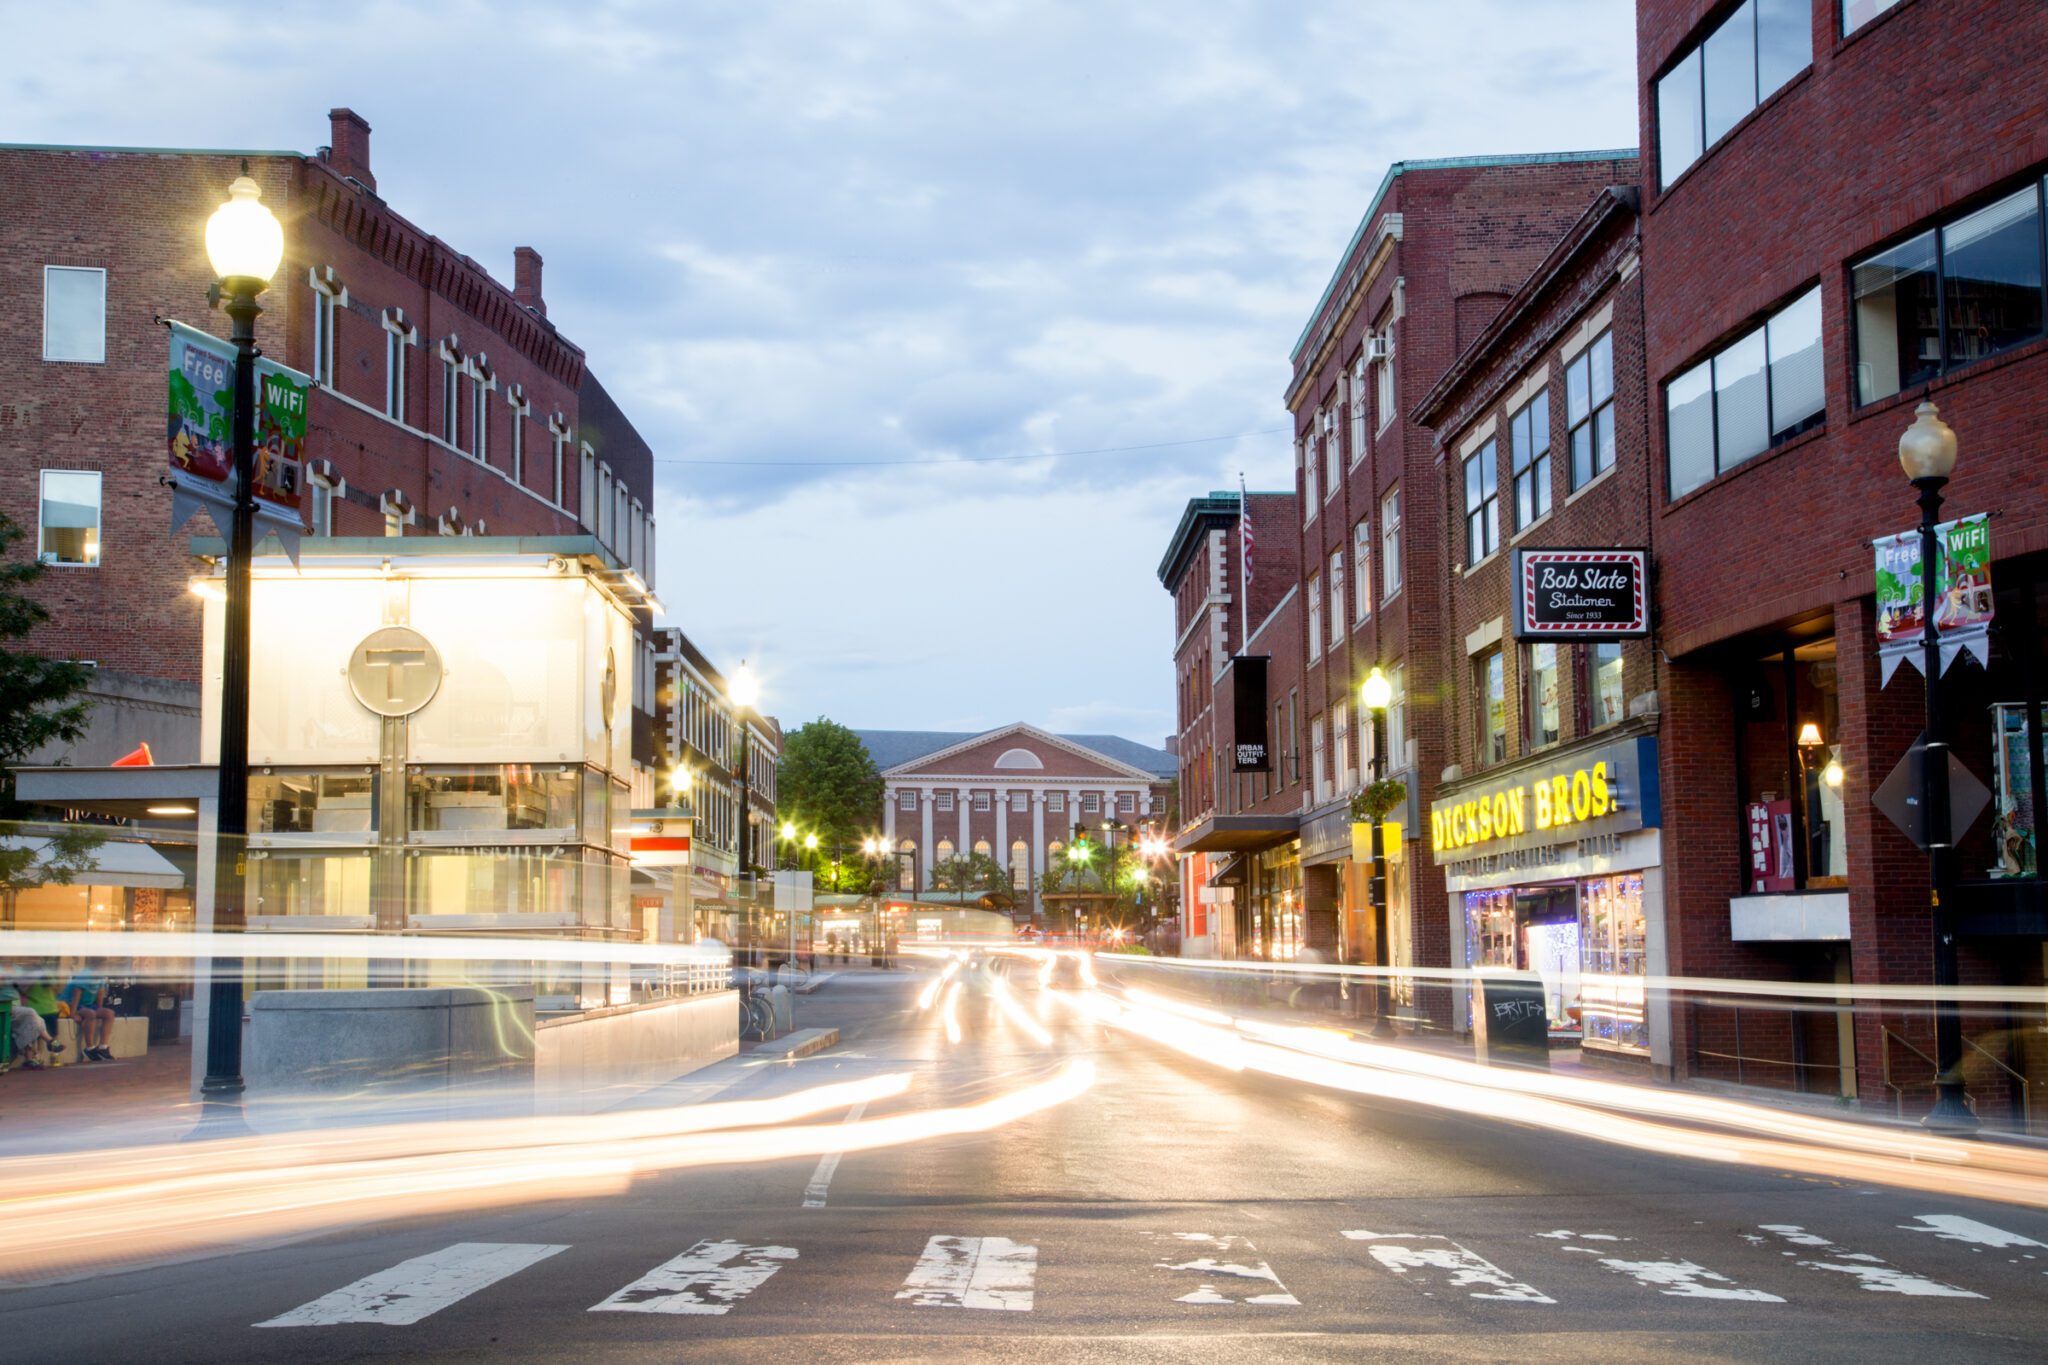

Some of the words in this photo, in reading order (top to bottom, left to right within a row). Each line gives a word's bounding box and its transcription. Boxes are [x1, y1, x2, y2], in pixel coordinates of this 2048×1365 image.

[184, 350, 223, 385] Free
[267, 383, 304, 415] WiFi
[1950, 528, 1985, 552] WiFi
[1885, 547, 1920, 567] Free
[1540, 567, 1578, 589] Bob
[1580, 568, 1628, 589] Slate
[1549, 592, 1616, 608] Stationer
[1566, 611, 1585, 619] Since
[1586, 611, 1602, 619] 1933
[366, 649, 425, 702] T
[1431, 786, 1525, 851] DICKSON
[1534, 761, 1617, 830] BROS.
